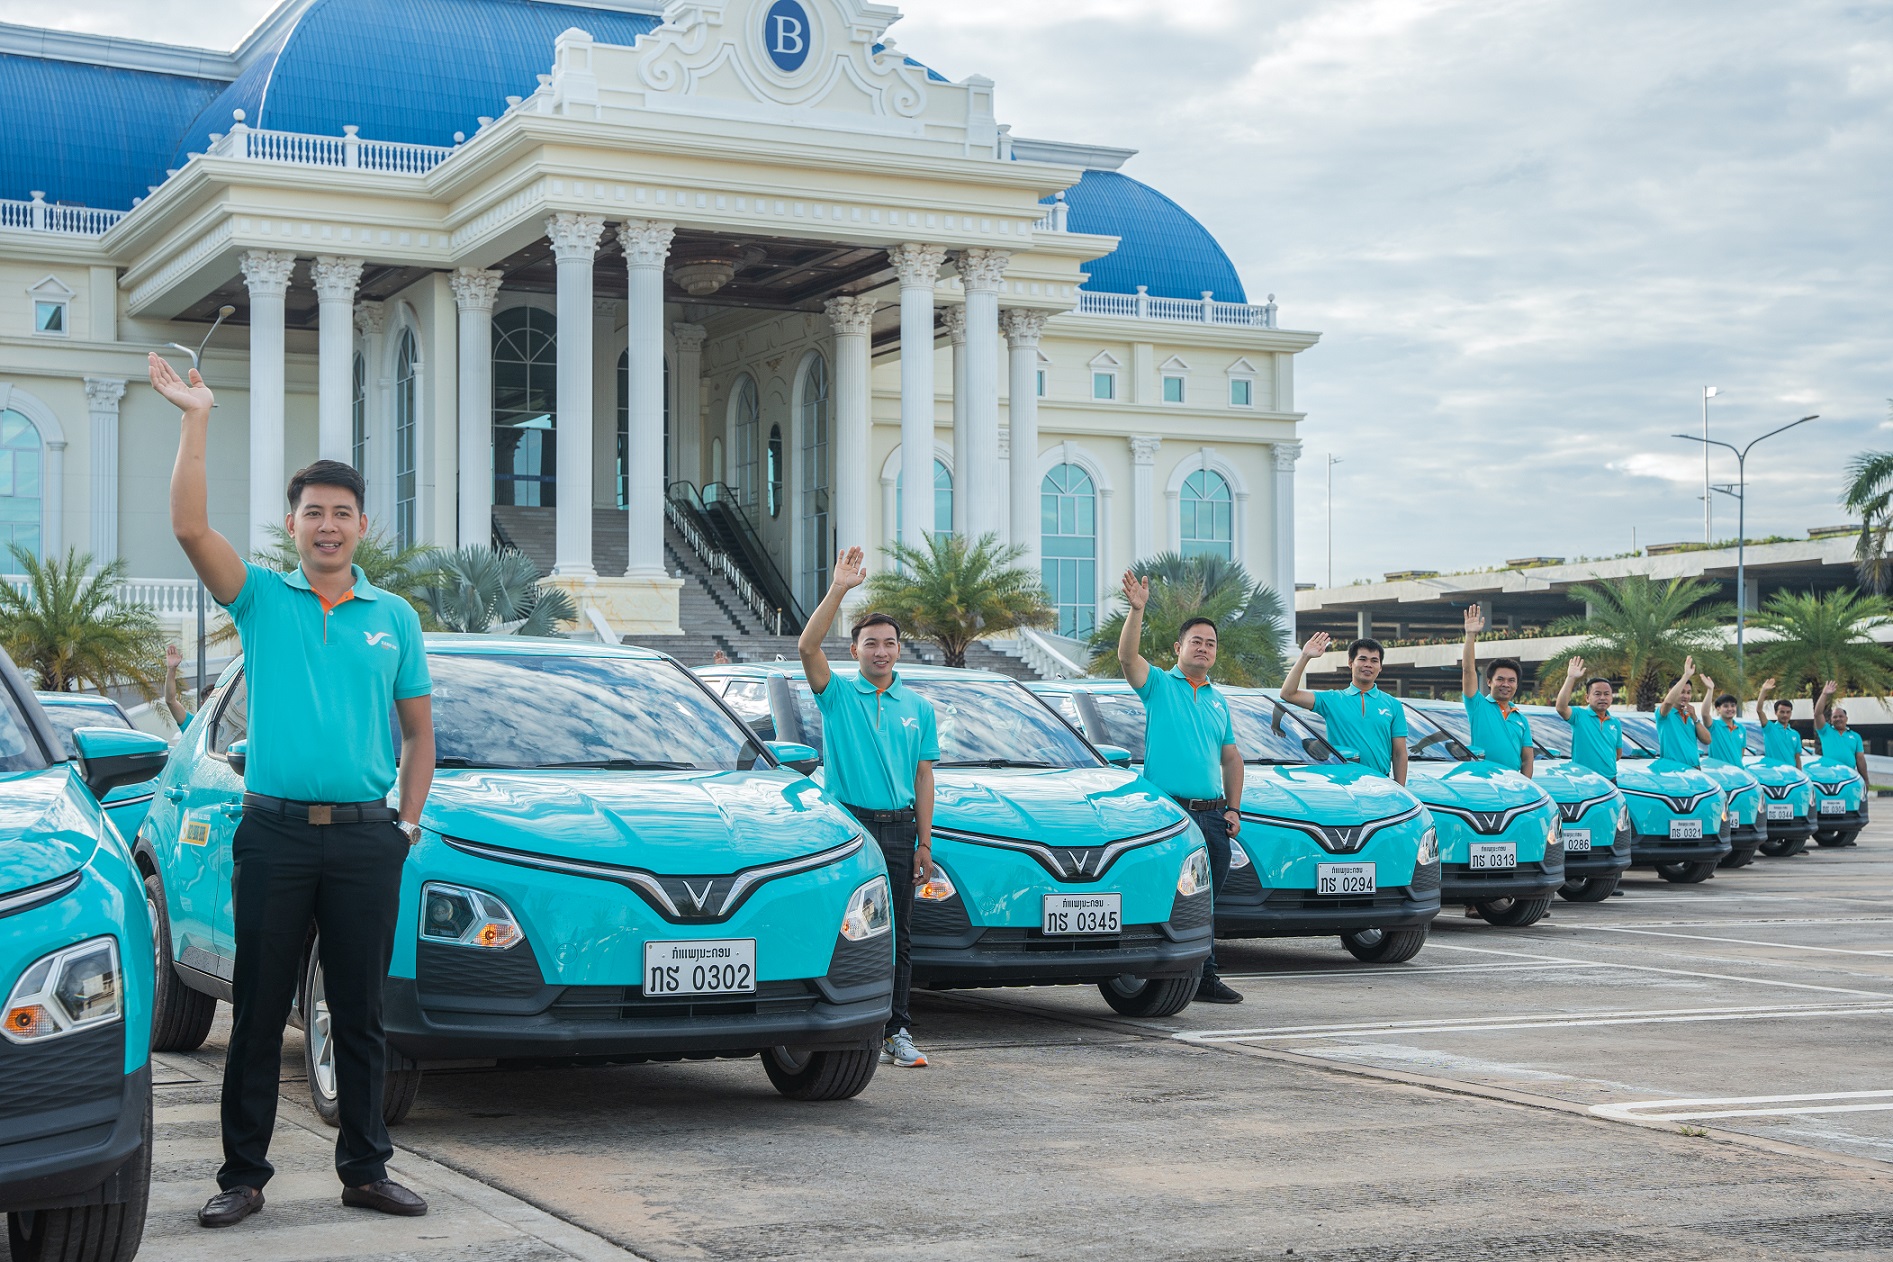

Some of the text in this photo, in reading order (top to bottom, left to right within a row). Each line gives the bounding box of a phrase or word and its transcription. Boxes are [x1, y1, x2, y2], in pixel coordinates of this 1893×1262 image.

[773, 15, 803, 54] B
[1684, 828, 1701, 838] 0321
[1490, 853, 1515, 867] 0313
[1342, 876, 1373, 892] 0294
[1077, 911, 1118, 931] 0345
[692, 963, 751, 990] 0302
